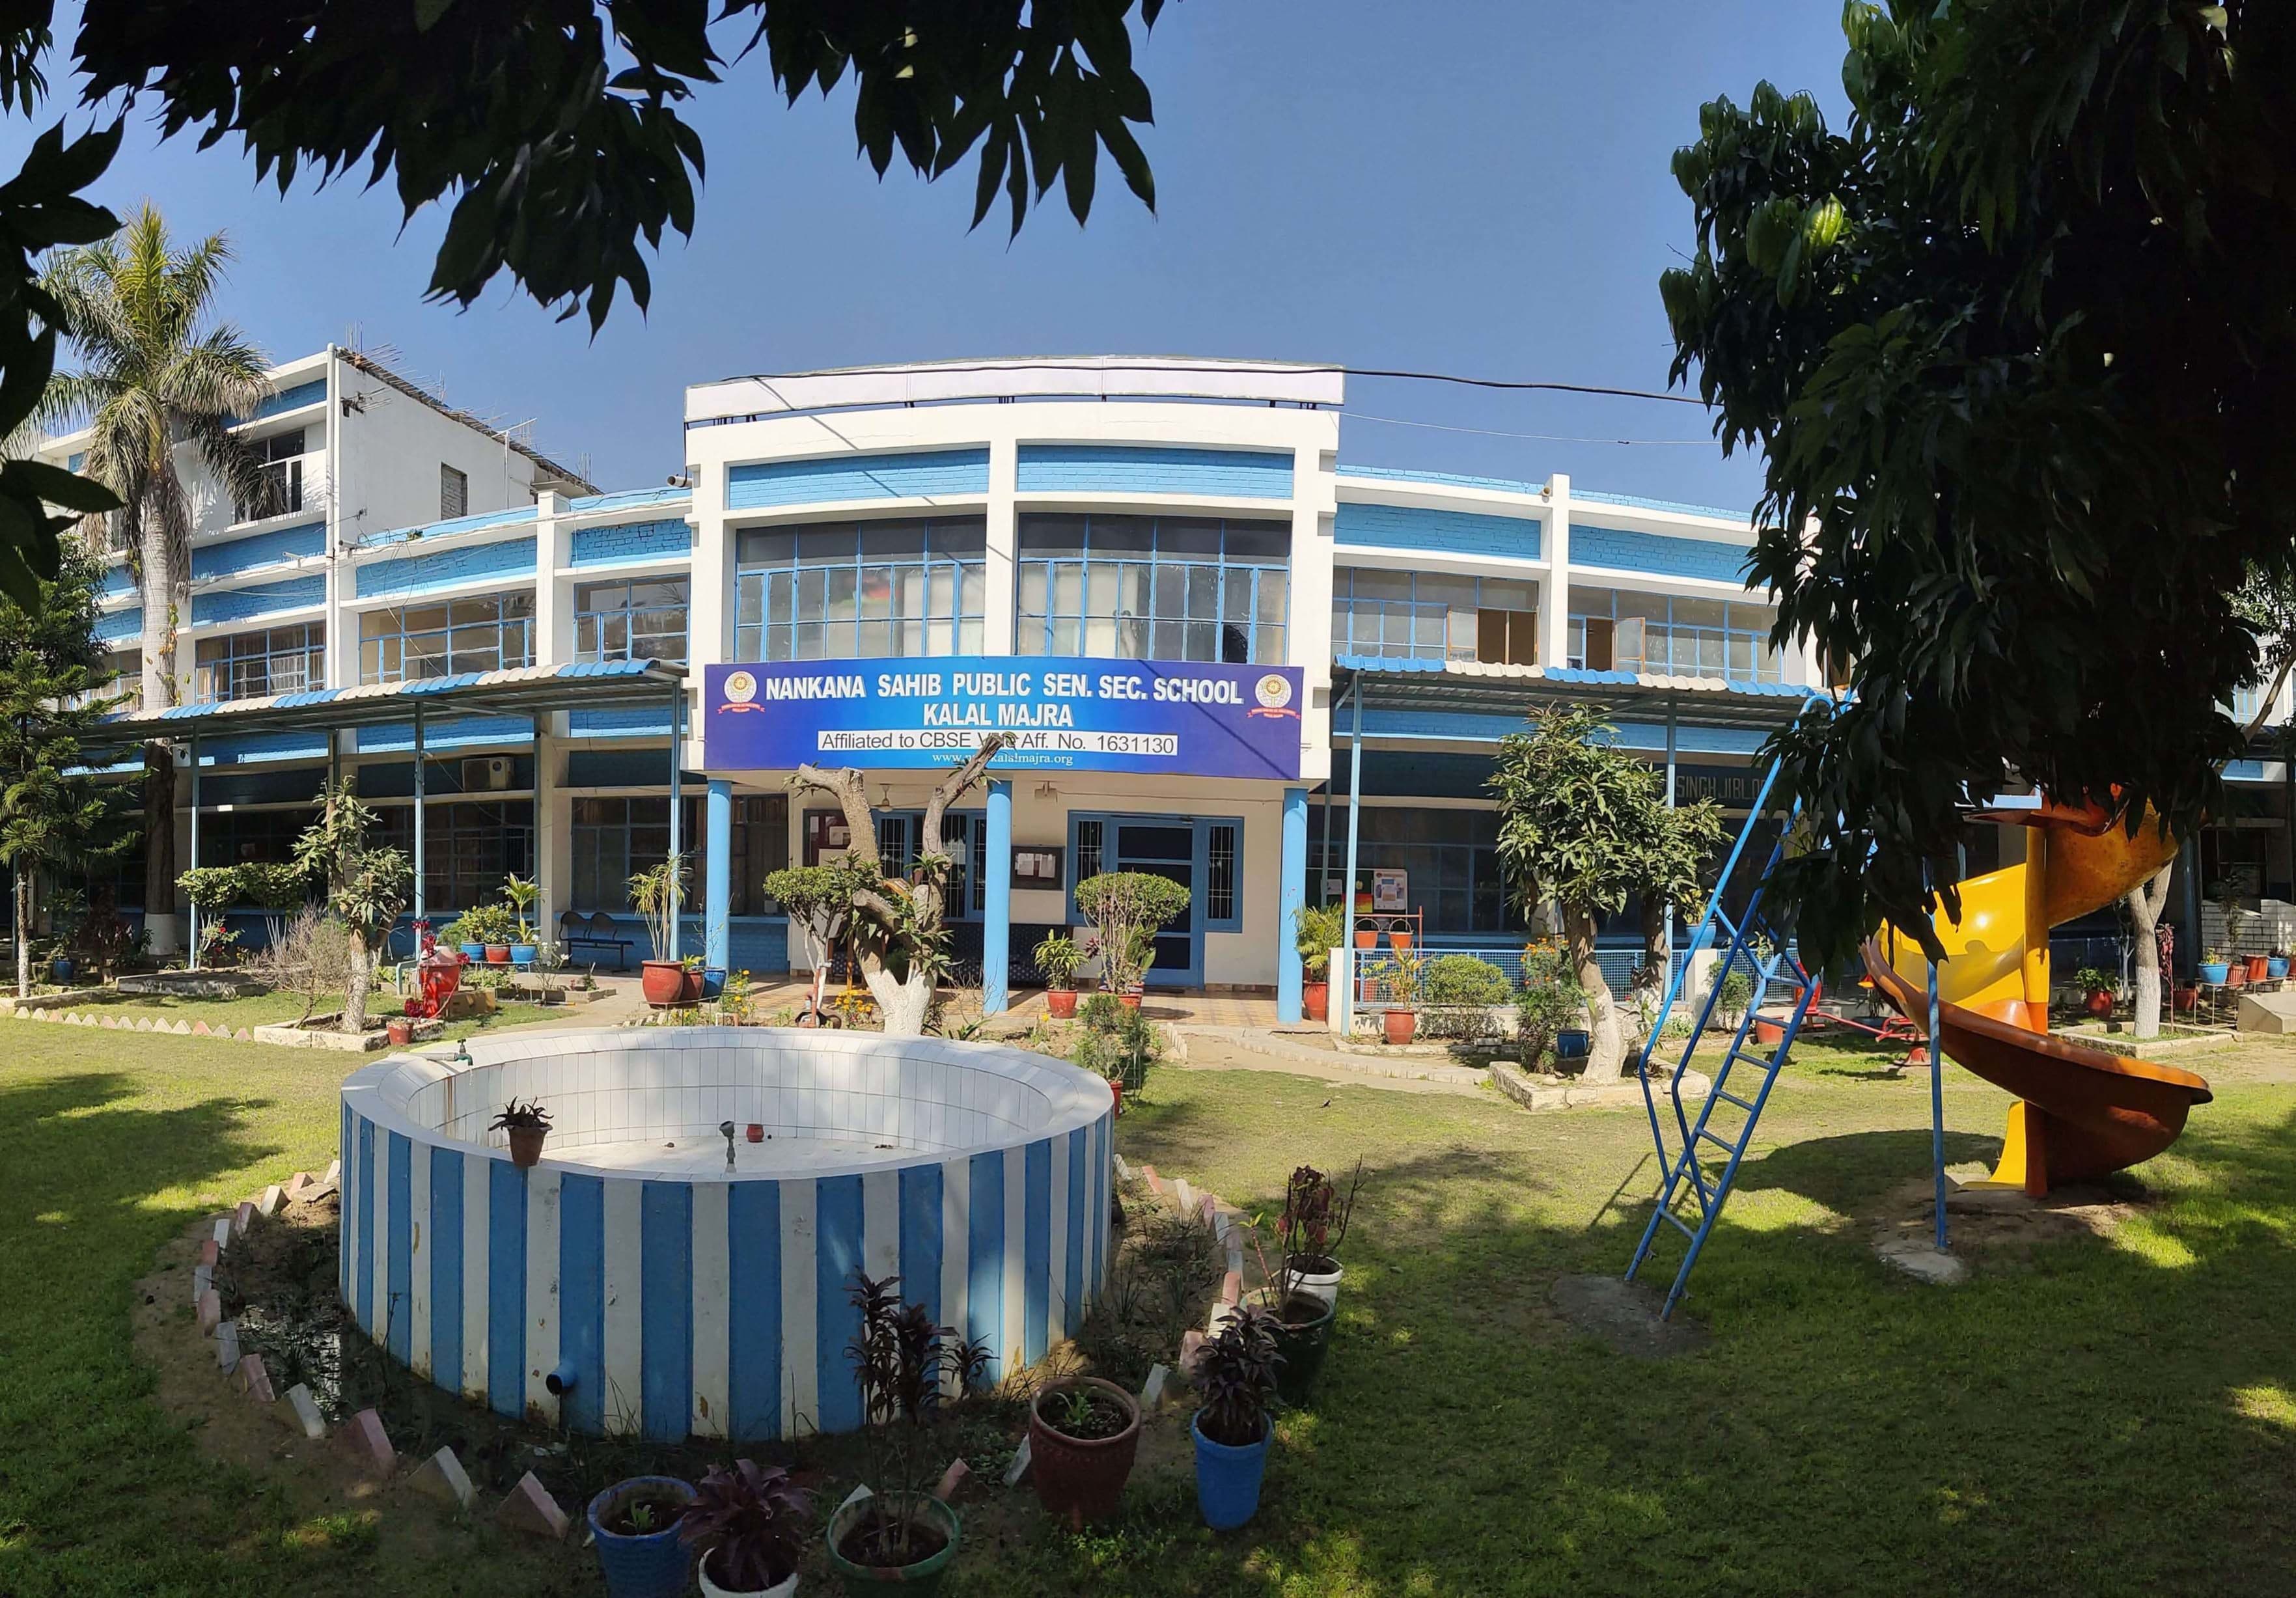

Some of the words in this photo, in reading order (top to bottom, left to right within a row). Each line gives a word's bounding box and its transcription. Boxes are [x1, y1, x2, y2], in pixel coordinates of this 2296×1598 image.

[766, 675, 866, 700] NANKANA
[877, 673, 941, 698] SAHIB
[952, 672, 1030, 696] PUBLIC
[1043, 672, 1092, 698] SEN.
[1098, 675, 1148, 700] SEC.
[1153, 678, 1244, 704] SCHOOL
[923, 703, 991, 726] KALAL
[998, 703, 1073, 727] MAJRA
[822, 734, 892, 749] Affiliated
[899, 734, 915, 748] to
[920, 732, 971, 747] CBSE
[1021, 734, 1049, 749] Aff.
[1058, 734, 1086, 750] No.
[1097, 736, 1174, 754] 1631130
[1676, 775, 1716, 798] SINGH
